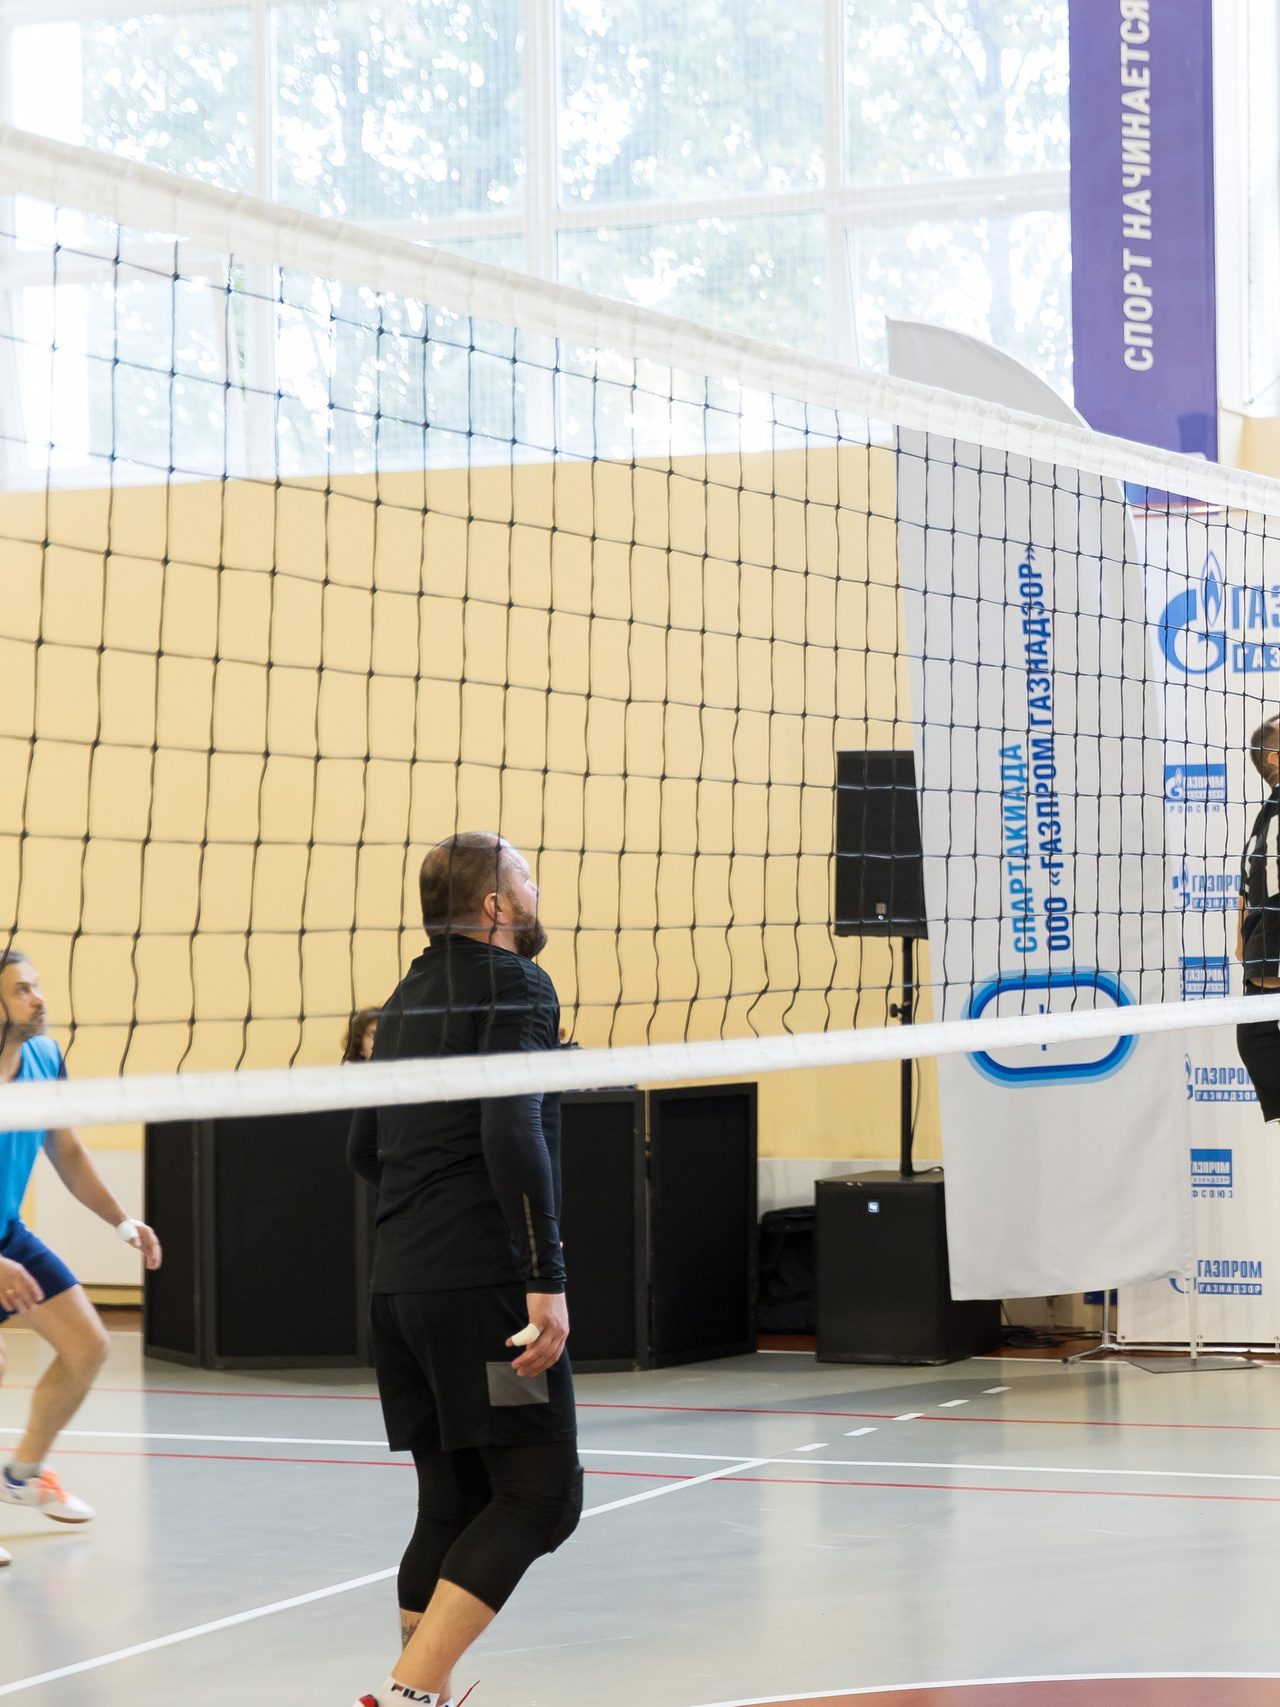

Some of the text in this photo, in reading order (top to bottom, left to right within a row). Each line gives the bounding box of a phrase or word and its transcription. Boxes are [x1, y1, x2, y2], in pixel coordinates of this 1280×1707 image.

[1120, 0, 1153, 372] СПОРТ НАЧИНАЕТСЯ
[1018, 546, 1071, 952] ООО «ГАЗПРОМ ГАЗНАДЗОР»
[999, 744, 1037, 954] СПАРТАКИАДА
[1192, 875, 1242, 892] ГАЗПРО
[1192, 1161, 1230, 1173] АЗПРОМ
[1191, 1190, 1233, 1199] ФСОЮЗ
[1197, 1259, 1262, 1279] ГАЗПРОМ
[1198, 1284, 1262, 1296] ГАЗНАДЗОР
[391, 1683, 431, 1704] FILA
